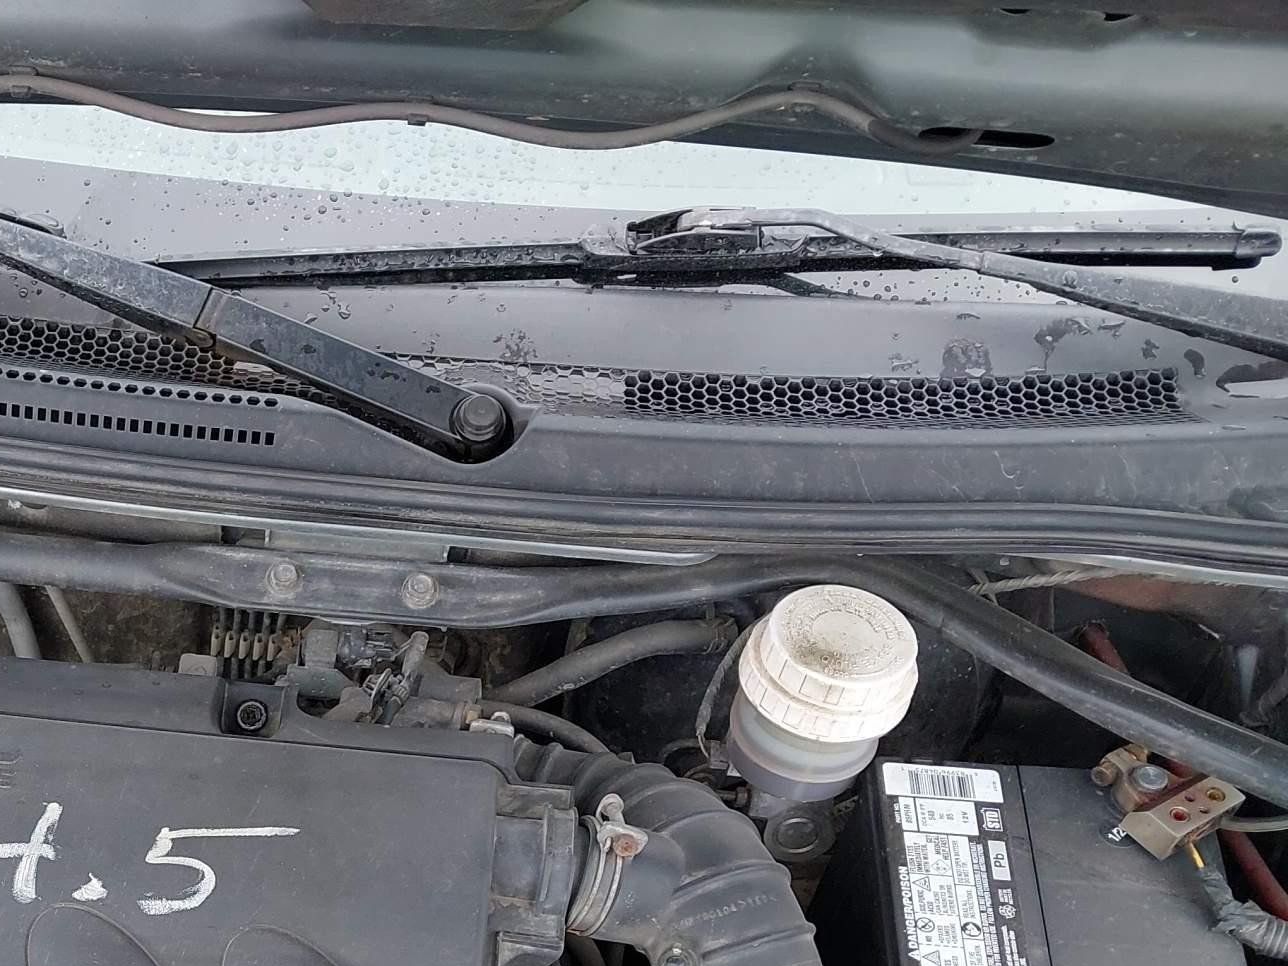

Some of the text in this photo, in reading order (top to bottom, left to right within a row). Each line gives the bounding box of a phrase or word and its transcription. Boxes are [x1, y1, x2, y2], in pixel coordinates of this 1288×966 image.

[961, 810, 969, 823] 12V
[984, 810, 1000, 828] STD
[913, 842, 923, 872] IMMEDIATELY
[992, 853, 1005, 867] Pb
[898, 866, 918, 948] DANGER/POISON
